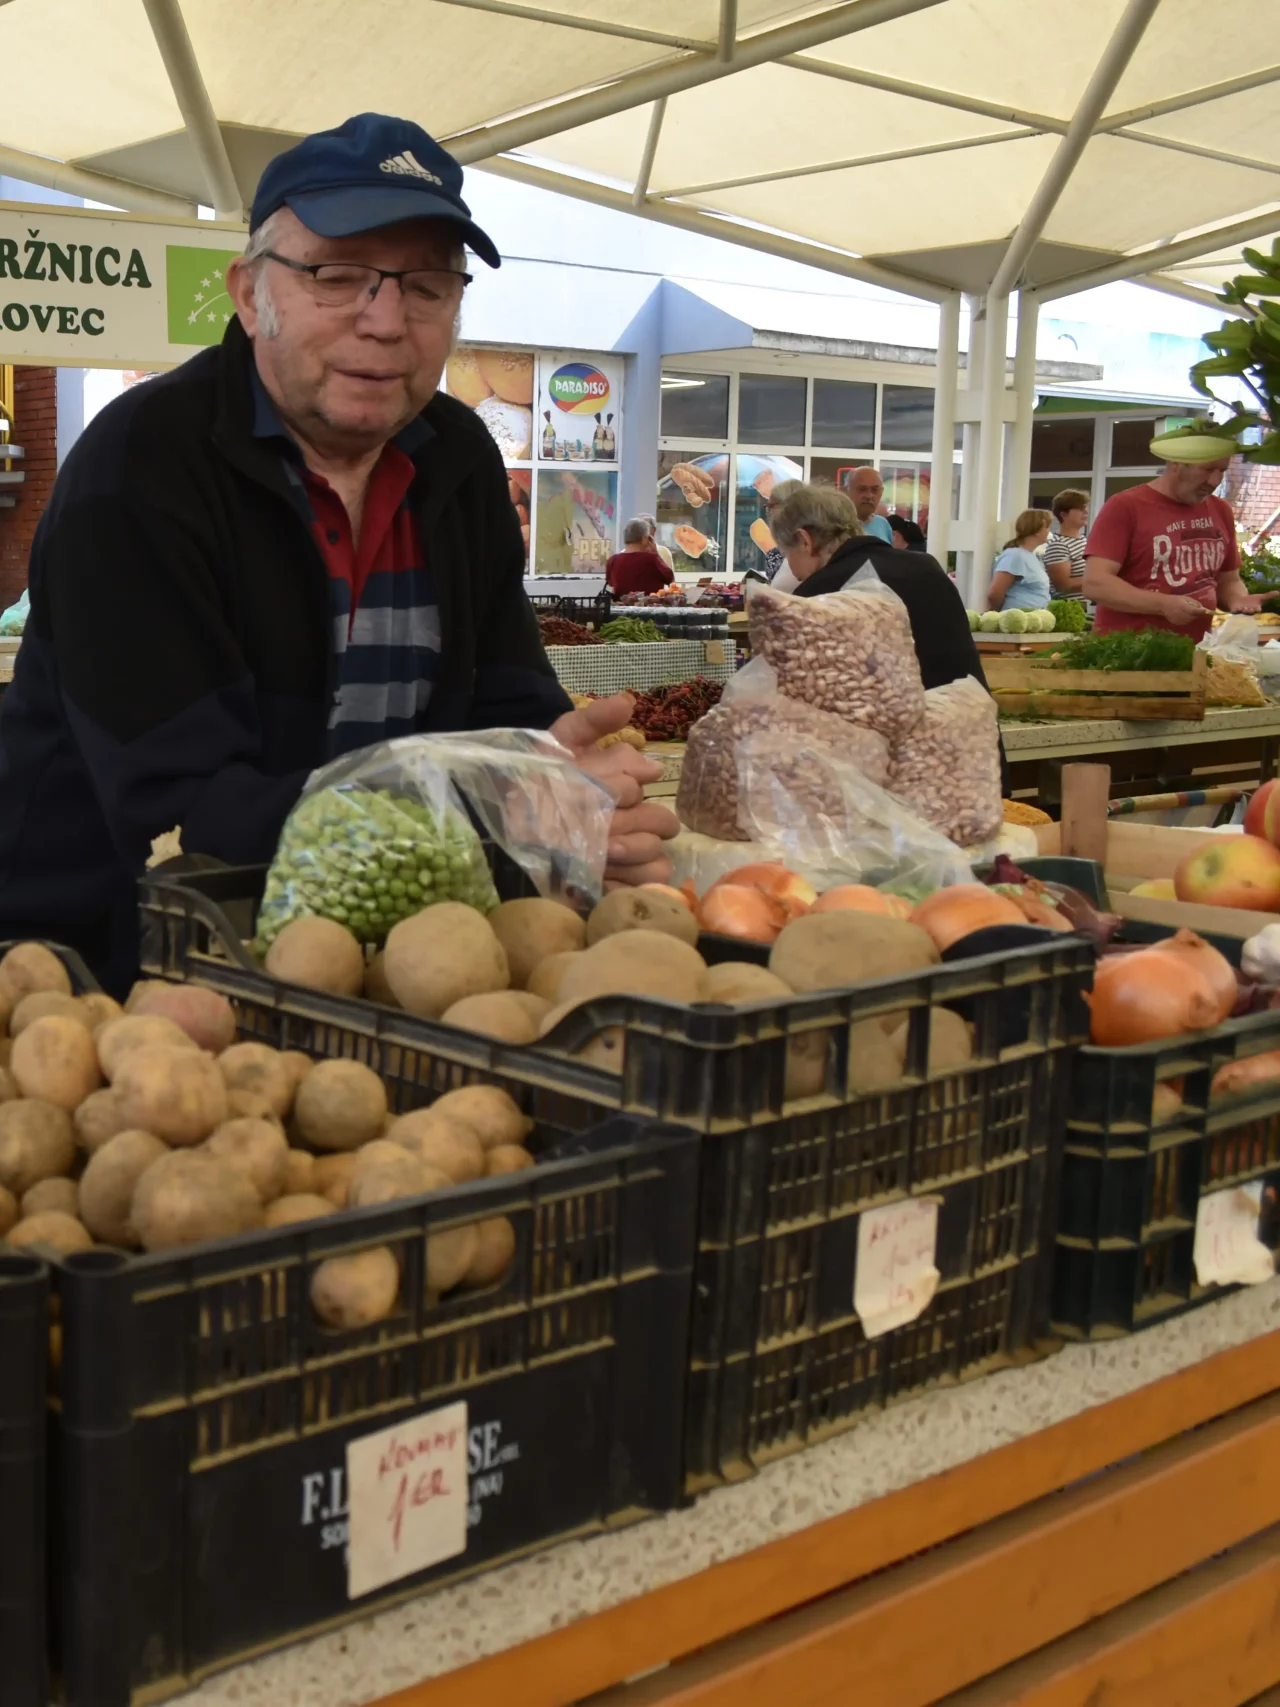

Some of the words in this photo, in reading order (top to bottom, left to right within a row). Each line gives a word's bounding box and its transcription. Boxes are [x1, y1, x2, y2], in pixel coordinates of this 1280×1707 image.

[554, 380, 605, 395] PARADISO
[1166, 520, 1186, 533] WAVE
[1190, 516, 1214, 529] BREAK
